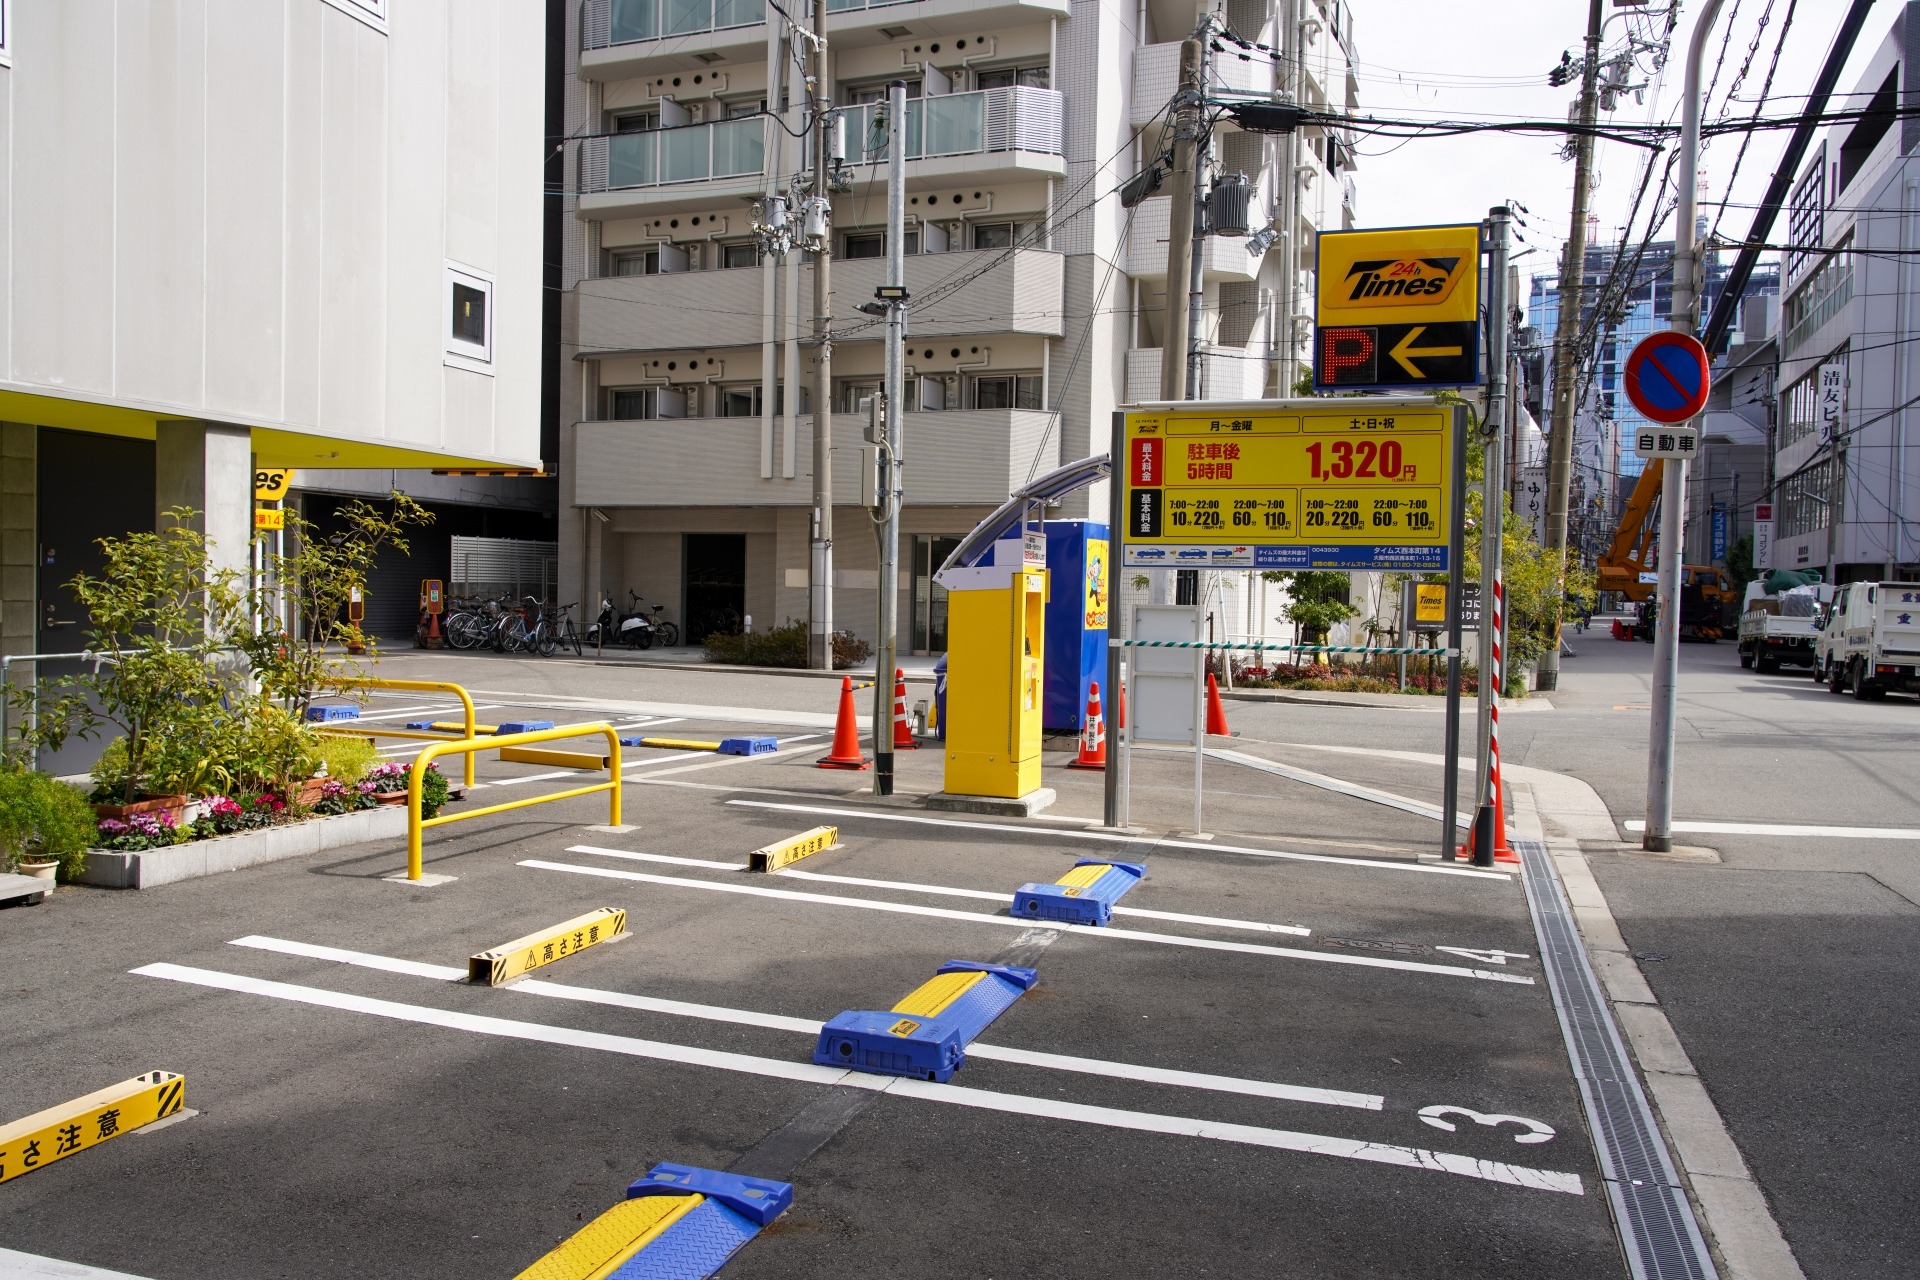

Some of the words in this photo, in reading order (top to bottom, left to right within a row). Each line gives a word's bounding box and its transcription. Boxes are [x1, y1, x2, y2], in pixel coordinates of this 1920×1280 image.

[1390, 262, 1421, 277] 24h
[1344, 260, 1452, 301] Times
[1324, 329, 1373, 384] P
[1210, 420, 1253, 432] 月～金曜
[1350, 418, 1395, 429] 土・日・祝
[1187, 443, 1240, 460] 駐車後
[1639, 434, 1694, 452] 自動車
[1141, 443, 1152, 482] 最大料金
[1305, 440, 1416, 482] 1,320円
[1187, 463, 1233, 480] 5時間
[1140, 493, 1151, 532] 基本料金
[1419, 595, 1442, 605] Times
[543, 925, 599, 963] 高さ注意
[1435, 945, 1530, 965] 4
[1417, 1104, 1556, 1144] 3
